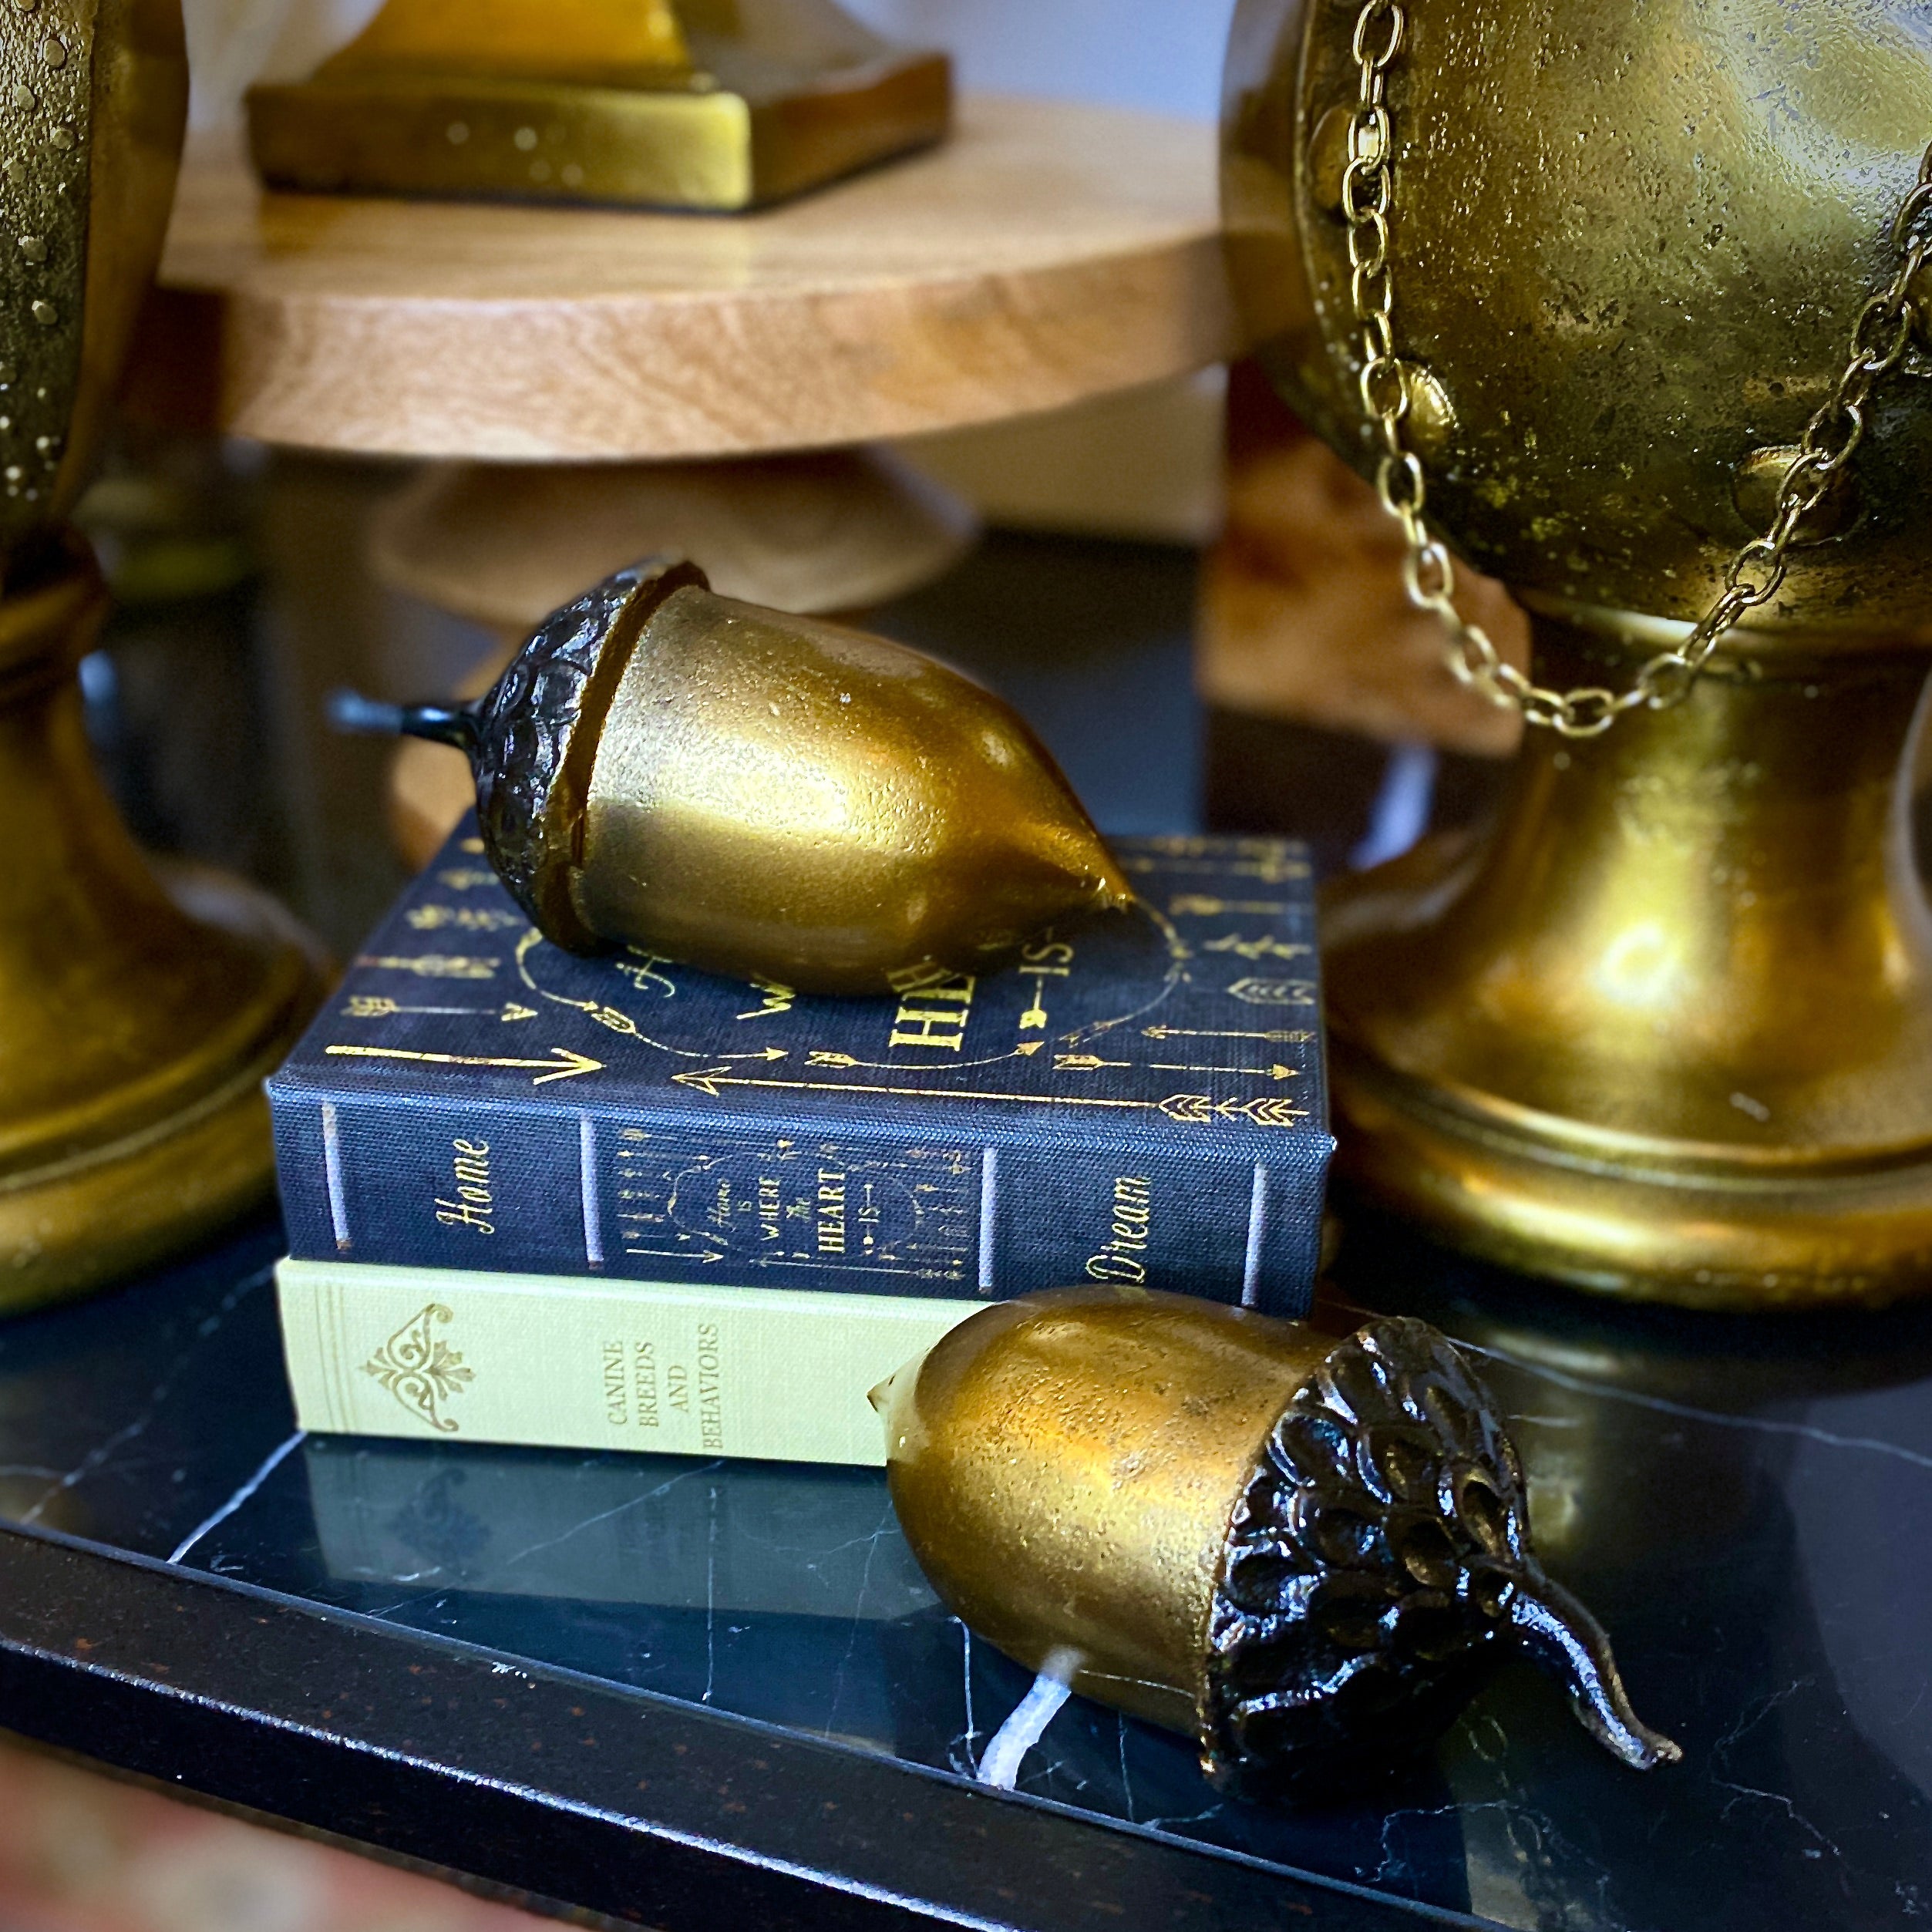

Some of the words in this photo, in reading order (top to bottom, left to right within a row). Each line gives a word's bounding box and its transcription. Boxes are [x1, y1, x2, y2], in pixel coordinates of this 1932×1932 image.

[433, 1138, 495, 1234] Home
[758, 1176, 780, 1241] WHERE
[817, 1167, 846, 1254] HEART
[1084, 1175, 1152, 1284] Dream
[603, 1340, 628, 1425] CANINE
[634, 1341, 659, 1428] BREEDS
[668, 1365, 689, 1414] AND
[698, 1323, 724, 1449] BEHAVIORS
